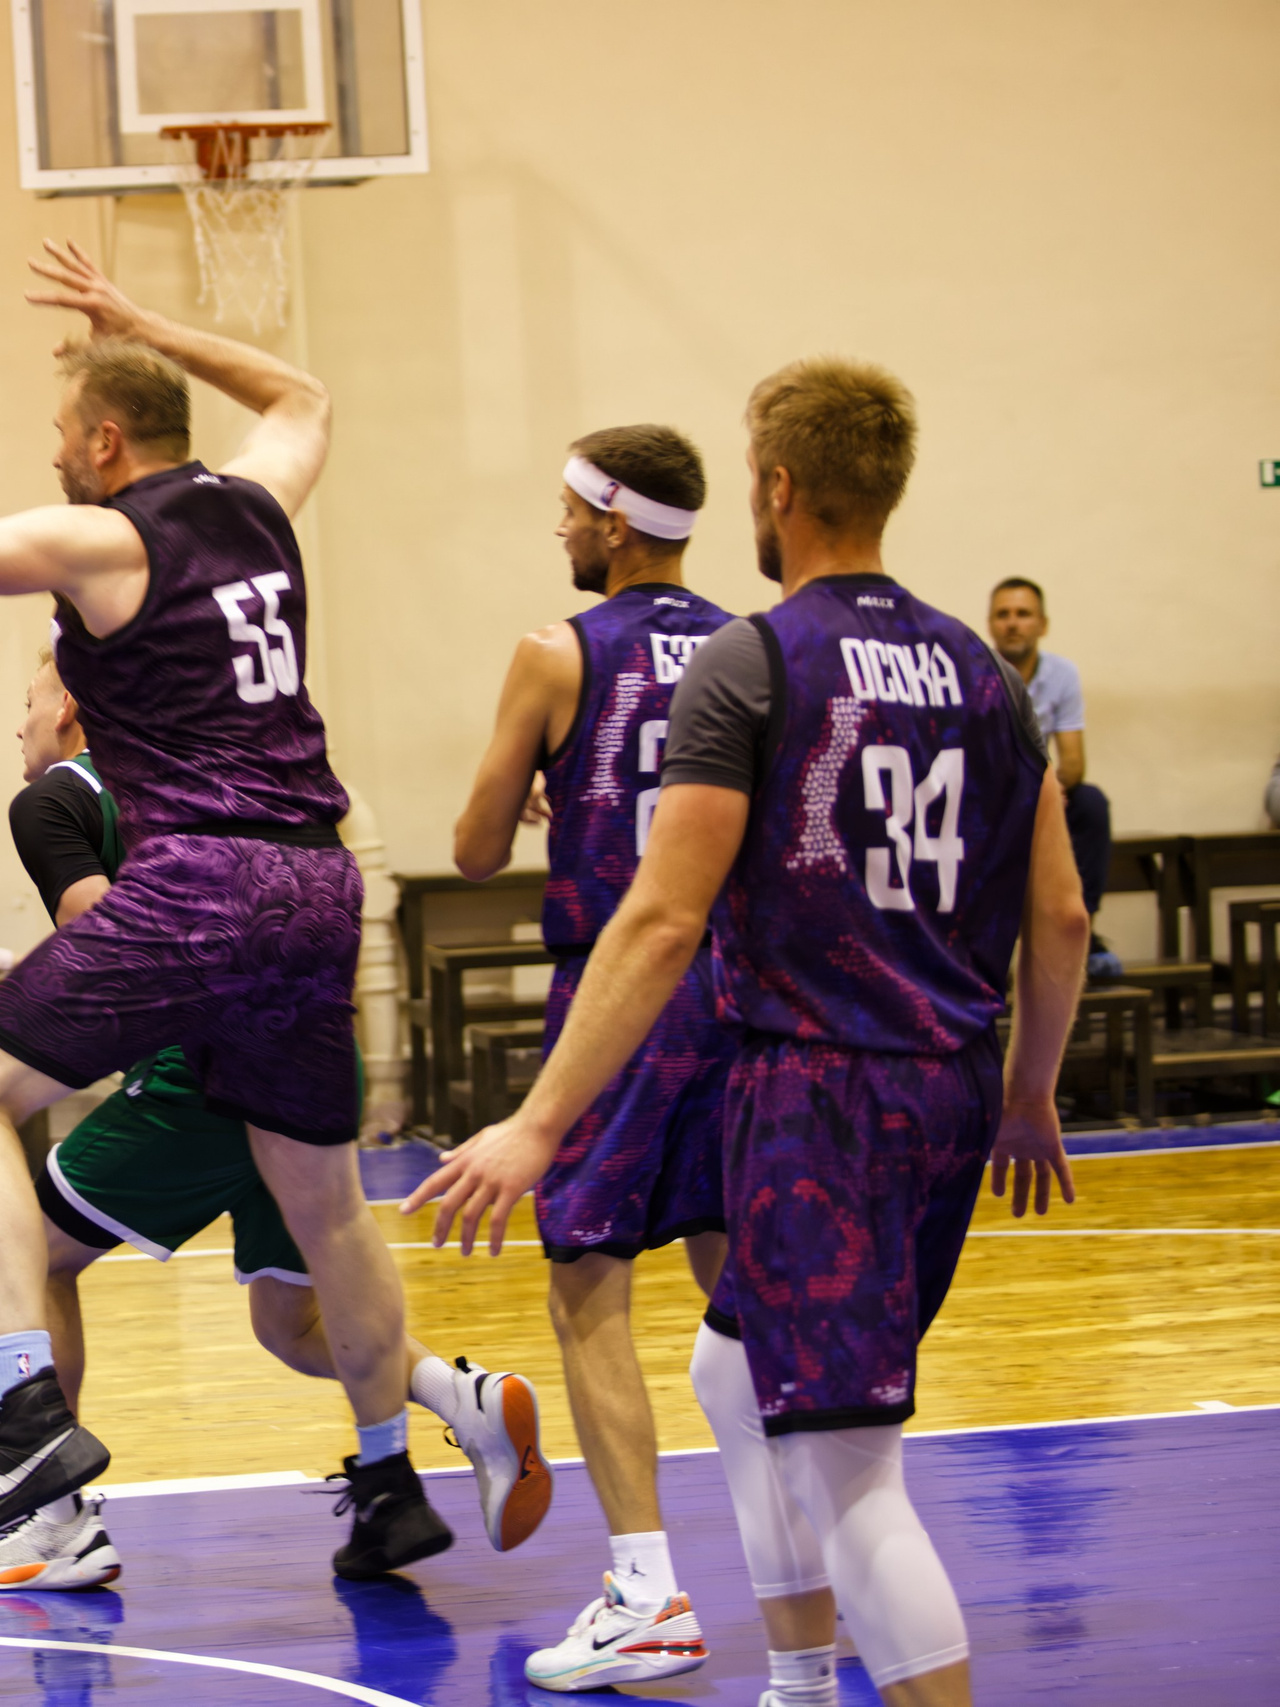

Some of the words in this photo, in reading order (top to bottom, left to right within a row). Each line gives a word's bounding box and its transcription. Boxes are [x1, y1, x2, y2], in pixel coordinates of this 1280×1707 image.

[212, 570, 299, 704] 55
[839, 637, 964, 707] ОСОКА
[861, 745, 965, 913] 34
